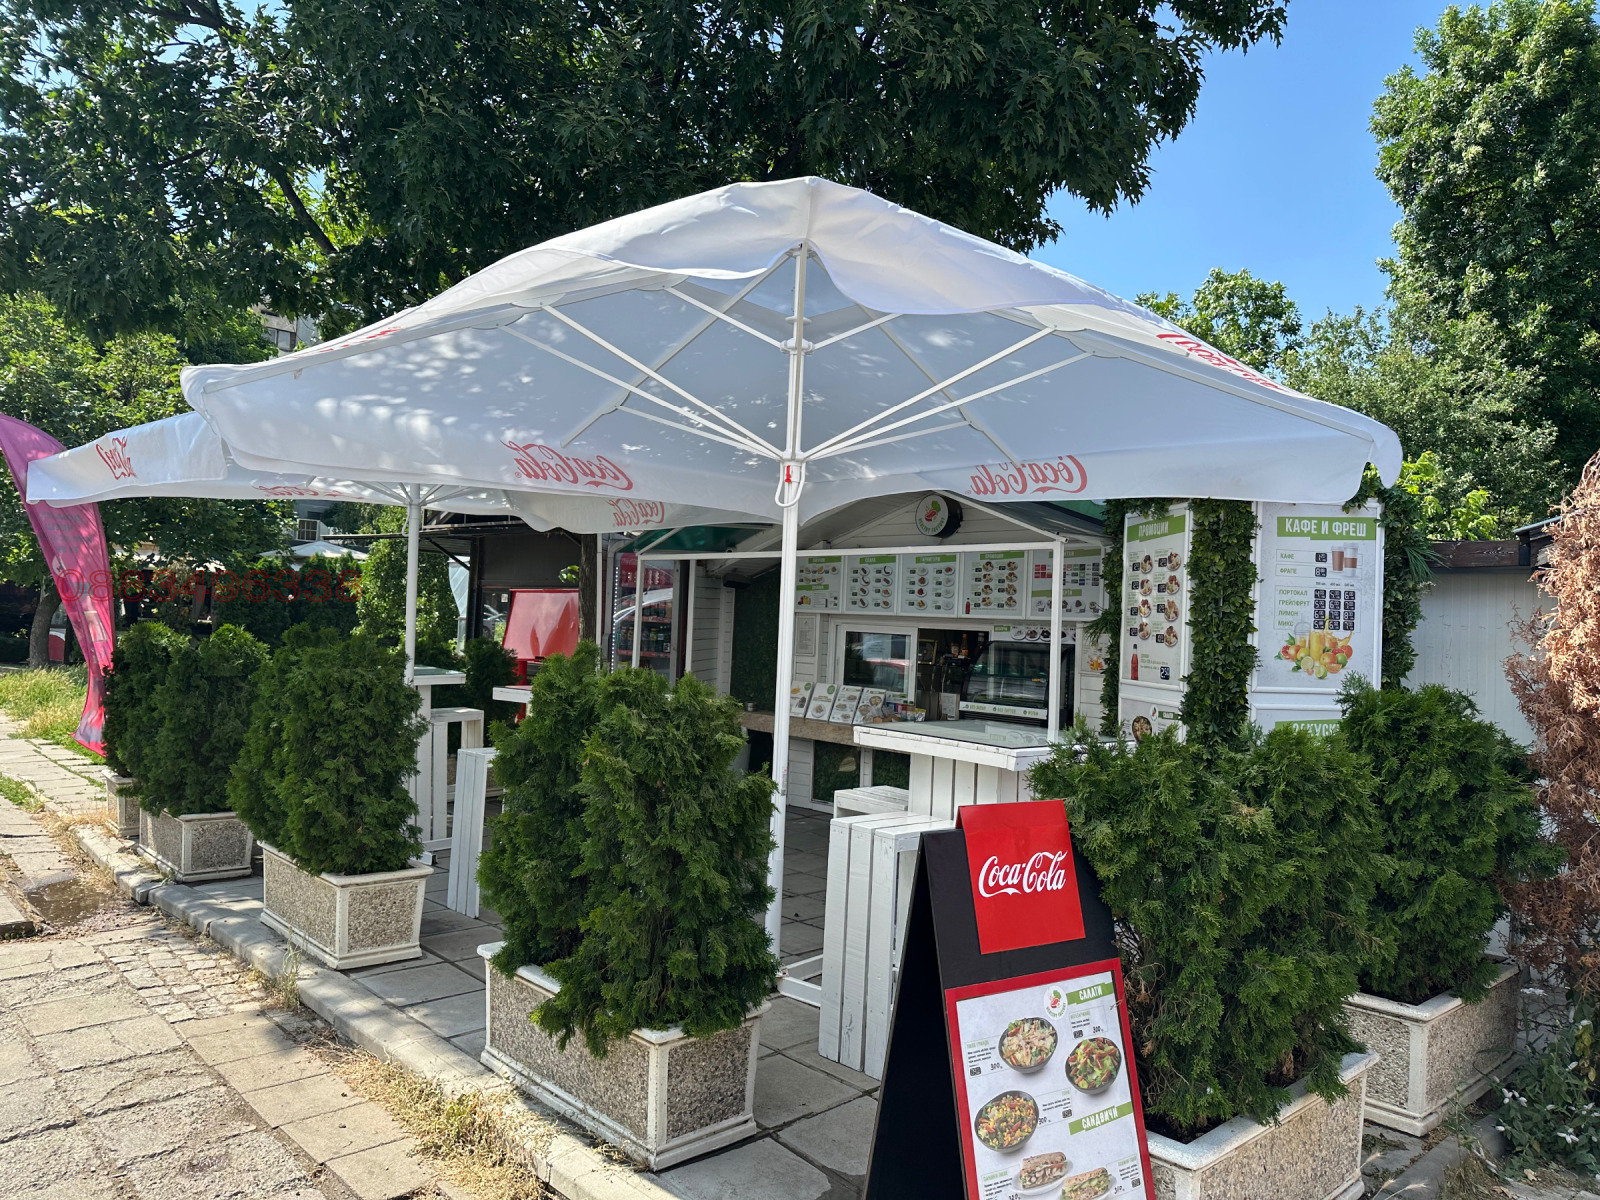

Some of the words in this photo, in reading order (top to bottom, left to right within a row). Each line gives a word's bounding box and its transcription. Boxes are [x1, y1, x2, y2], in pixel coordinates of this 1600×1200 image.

[1139, 521, 1168, 537] ПРОМОЦИИ
[1285, 518, 1317, 534] КАФЕ
[1322, 520, 1328, 535] И
[1332, 521, 1366, 537] ФРЕШ
[978, 850, 1068, 898] Coca-Cola
[1079, 985, 1102, 1000] САЛАТИ
[1082, 1106, 1118, 1128] САНДВИЧИ
